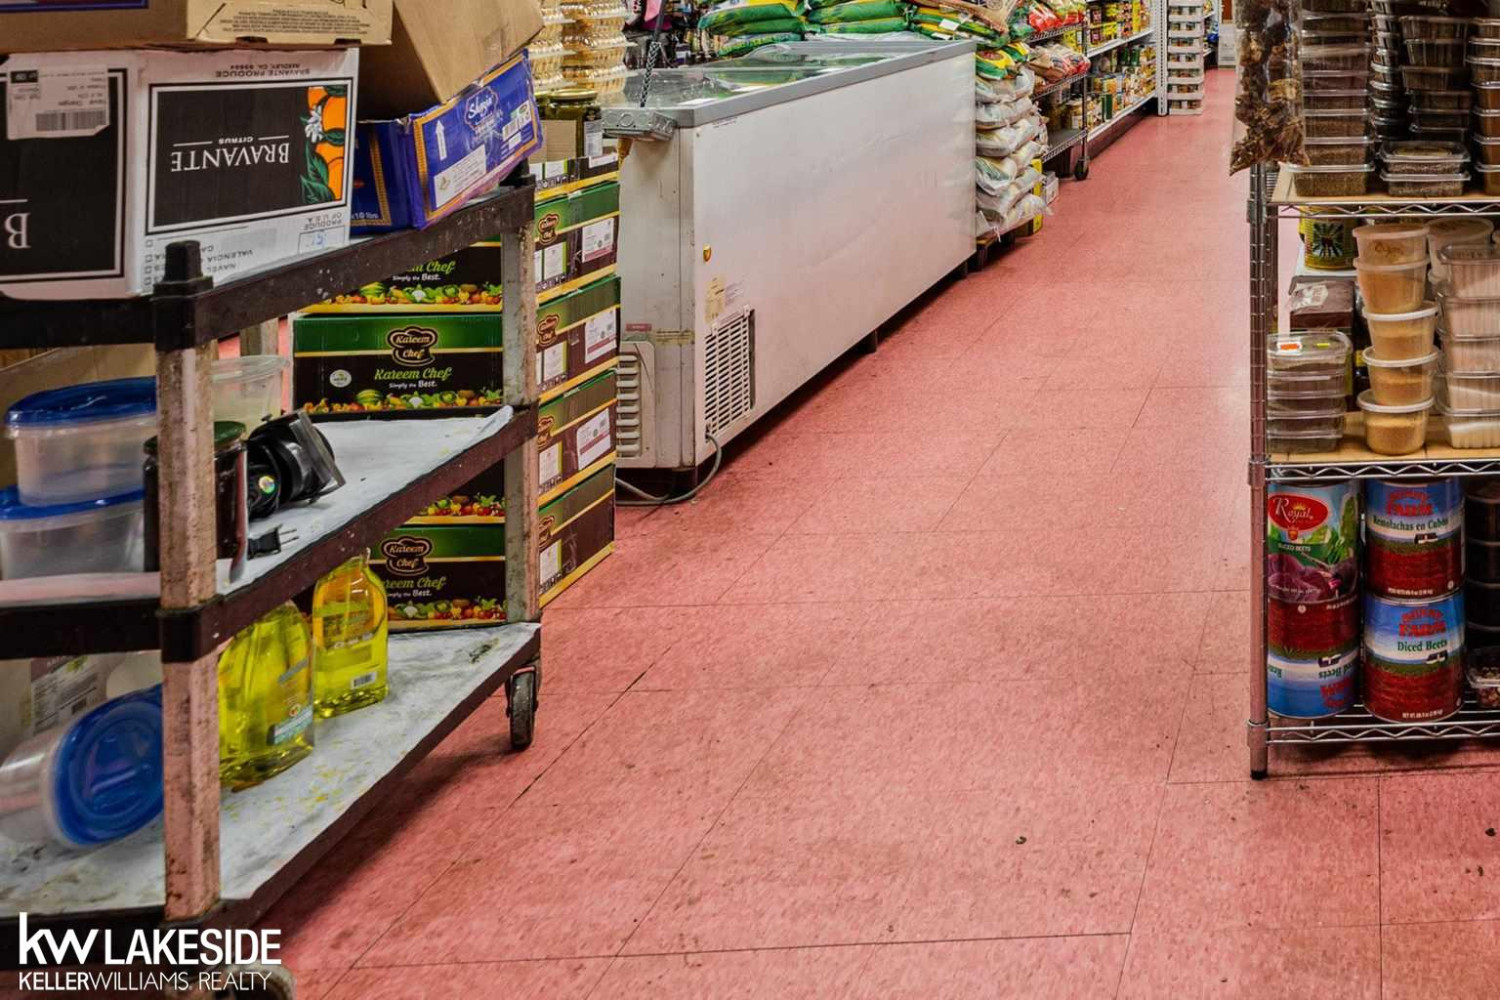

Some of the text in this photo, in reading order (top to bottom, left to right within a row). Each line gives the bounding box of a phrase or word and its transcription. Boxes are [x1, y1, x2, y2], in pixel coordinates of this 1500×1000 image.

[215, 69, 266, 78] PRODUCE
[217, 136, 253, 144] CITRUS
[170, 142, 289, 172] BRAVANTE
[331, 211, 342, 220] OF
[303, 218, 342, 230] PRODUCE
[207, 249, 254, 263] VALENCIA
[206, 262, 236, 273] NAVEL
[426, 260, 456, 274] Chef
[421, 272, 441, 281] Best.
[394, 334, 430, 344] Kareem
[401, 349, 425, 360] Chef
[374, 366, 453, 381] Kareem Chef
[418, 379, 438, 388] Best.
[1272, 497, 1312, 524] Royal
[389, 544, 425, 554] Kareem
[396, 558, 419, 569] Chef
[383, 577, 447, 590] reem Chef
[412, 589, 432, 597] Best.
[1397, 639, 1448, 652] Diced Beets
[1318, 668, 1342, 680] Beets
